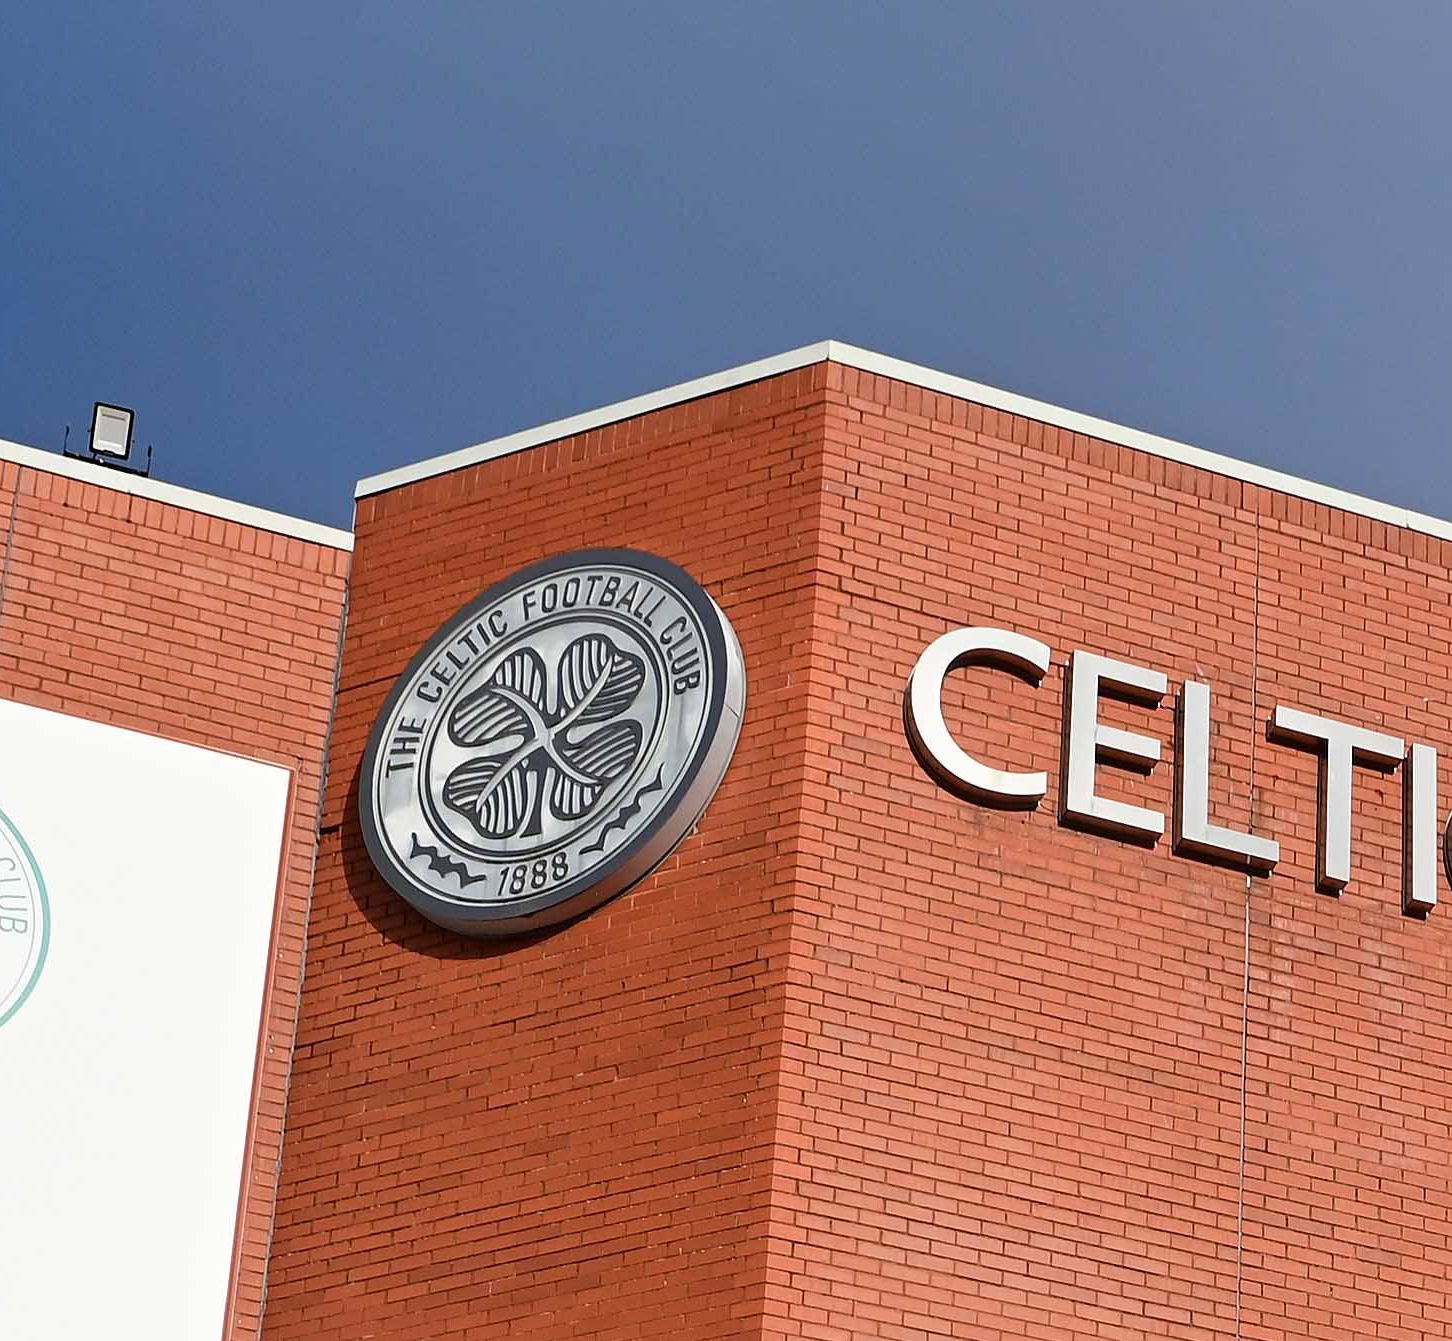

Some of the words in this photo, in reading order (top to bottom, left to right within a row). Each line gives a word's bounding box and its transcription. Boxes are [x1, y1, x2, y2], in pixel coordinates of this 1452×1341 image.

[385, 716, 427, 779] THE
[416, 610, 508, 703] CELTIC
[523, 575, 667, 628] FOOTBALL
[659, 616, 701, 695] CLUB
[497, 852, 568, 896] 1888
